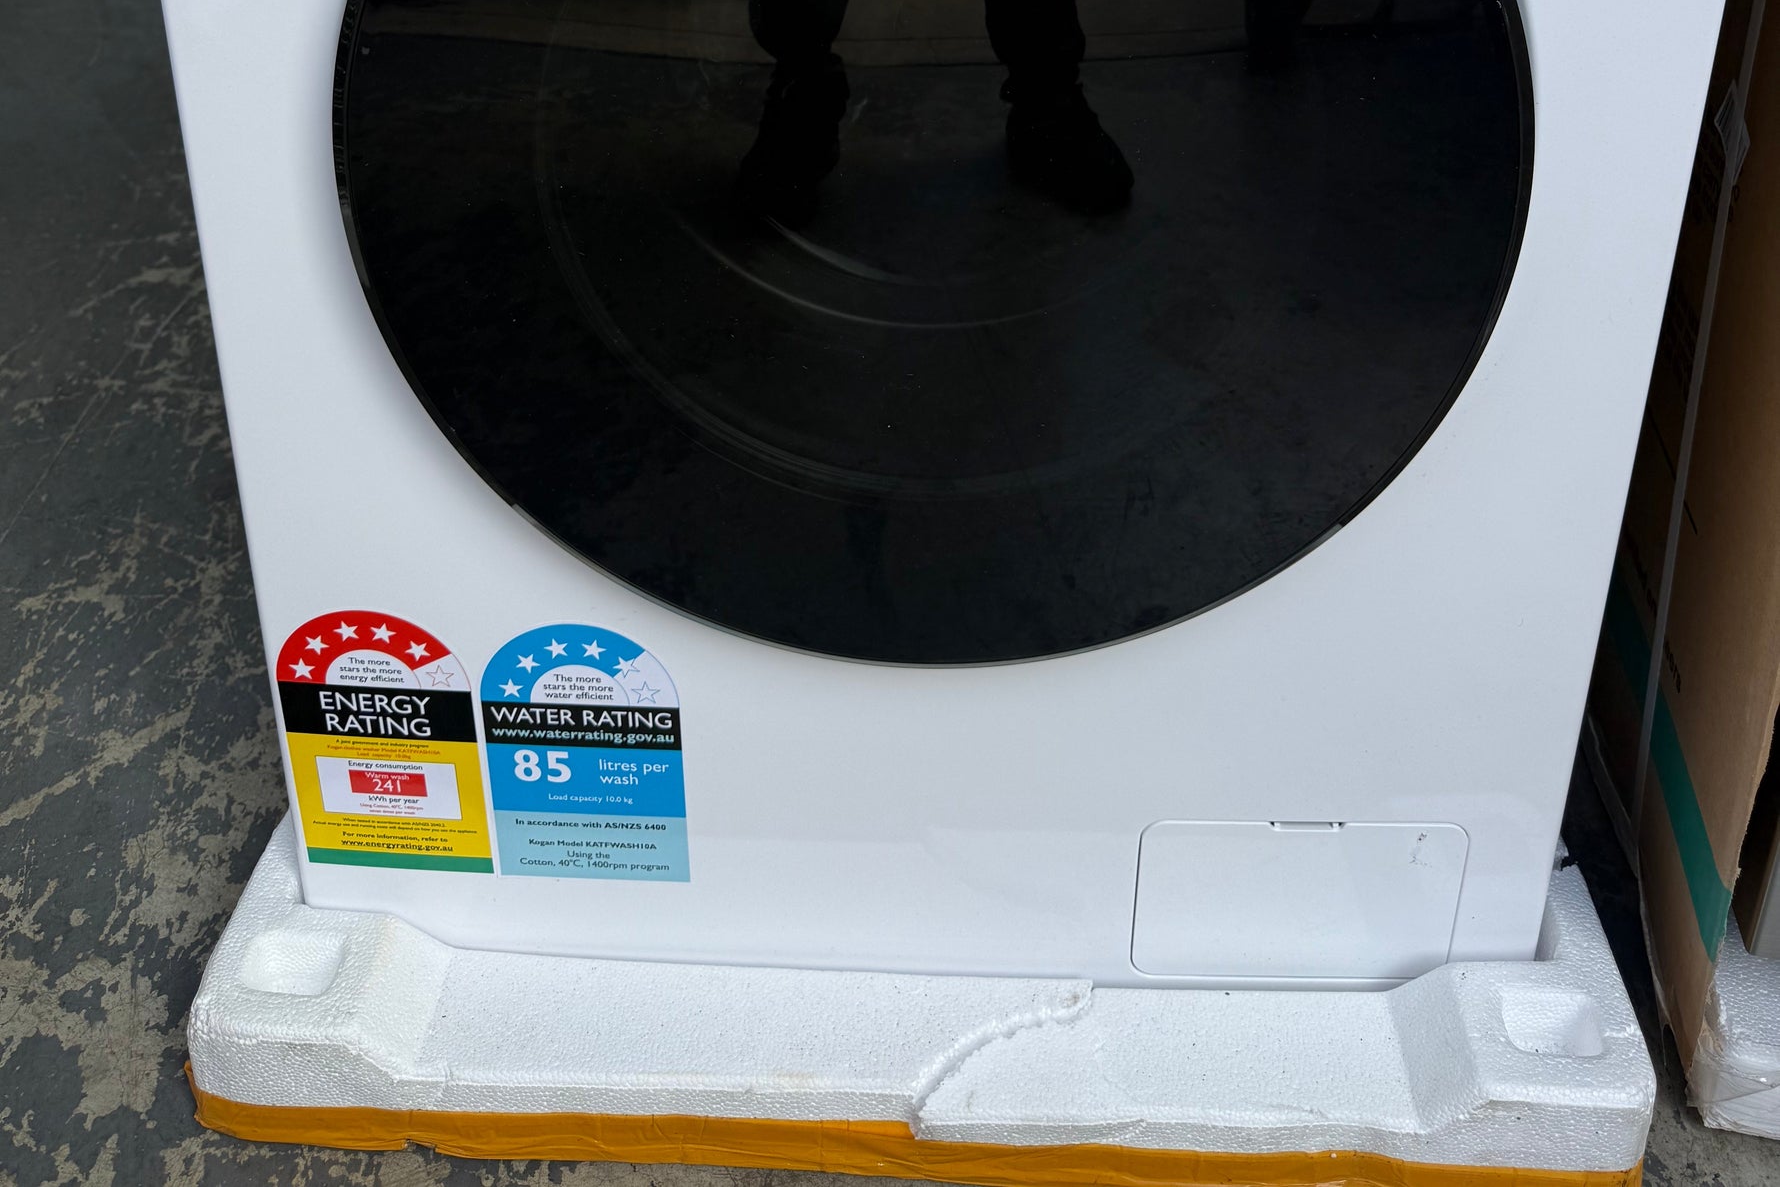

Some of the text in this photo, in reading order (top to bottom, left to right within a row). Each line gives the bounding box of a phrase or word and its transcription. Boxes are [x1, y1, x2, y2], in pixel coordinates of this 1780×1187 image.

[348, 657, 366, 665] The
[339, 665, 361, 673] stars
[362, 666, 378, 674] the
[339, 674, 405, 684] energy efficient
[553, 674, 602, 684] The more
[543, 683, 614, 693] stars the more
[545, 692, 614, 701] water efficient
[319, 691, 431, 715] ENERGY
[490, 706, 673, 729] WATER RATING
[325, 713, 431, 736] RATING
[491, 727, 675, 743] www.waterrating.gov.au
[348, 760, 423, 771] Energy consumption
[514, 749, 669, 783] 85 litres per
[365, 772, 410, 781] Warm wash
[600, 774, 638, 785] wash
[372, 779, 402, 793] 241
[368, 795, 388, 803] kWh
[548, 793, 568, 801] Load
[570, 795, 602, 804] capacity
[624, 796, 633, 805] kg
[527, 818, 579, 828] accordance
[581, 821, 602, 829] with
[604, 822, 642, 830] AS/NZS
[341, 840, 453, 852] www.energyrating.gov.au
[528, 838, 556, 847] Kogan
[557, 839, 584, 847] Model
[567, 851, 611, 860] Using the
[520, 858, 556, 866] Cotton,
[587, 860, 628, 871] 1400rpm
[630, 863, 670, 872] program
